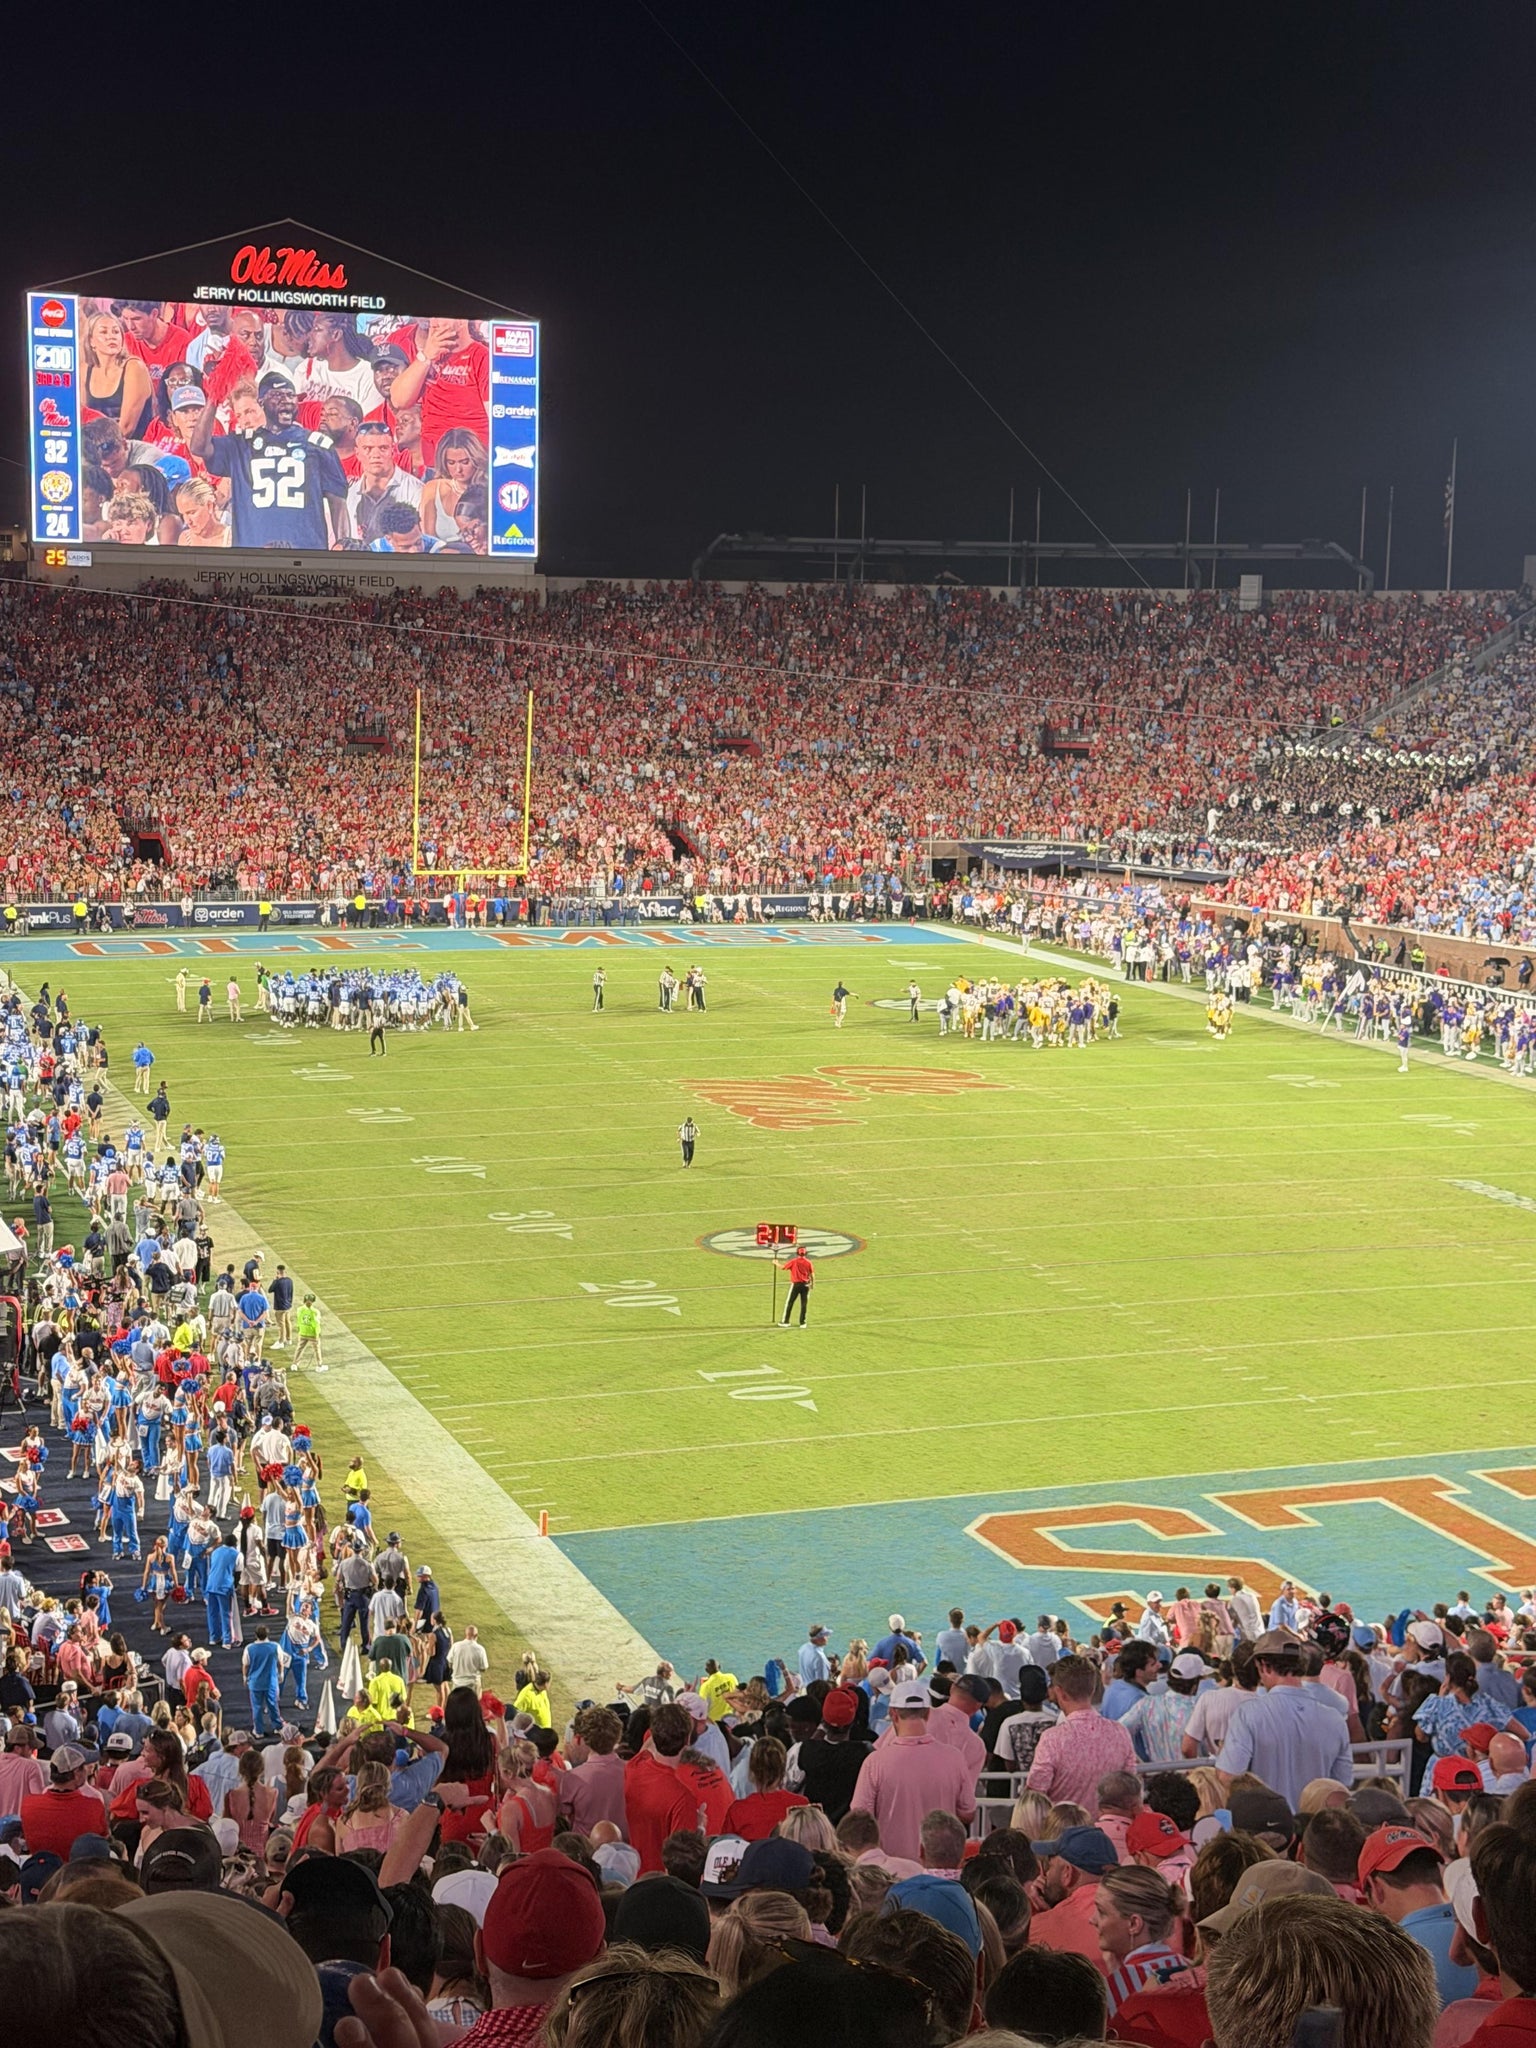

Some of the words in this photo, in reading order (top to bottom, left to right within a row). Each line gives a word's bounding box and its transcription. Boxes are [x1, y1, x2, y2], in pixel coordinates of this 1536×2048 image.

[231, 245, 277, 285] Ole
[276, 248, 348, 289] Miss
[193, 286, 236, 301] JERRY
[238, 289, 348, 307] HOLLINGSWORTH
[350, 296, 386, 310] FIELD
[36, 346, 71, 369] 2:00
[506, 405, 537, 416] arden
[44, 439, 68, 463] 32
[250, 456, 305, 509] 52
[46, 513, 70, 537] 24
[493, 535, 535, 546] REGIONS
[45, 549, 67, 566] 25
[193, 571, 236, 583] JERRY
[239, 572, 356, 587] HOLLINGSWORTH
[359, 575, 395, 588] FIELD
[209, 907, 244, 919] arden
[66, 931, 430, 959] OLE
[471, 928, 892, 947] MISS
[67, 1143, 80, 1156] 56
[206, 1151, 219, 1161] 87
[163, 1170, 177, 1181] 35
[487, 1210, 574, 1234] 30
[757, 1224, 797, 1245] 2:14
[577, 1279, 680, 1308] 20
[696, 1364, 813, 1401] 10
